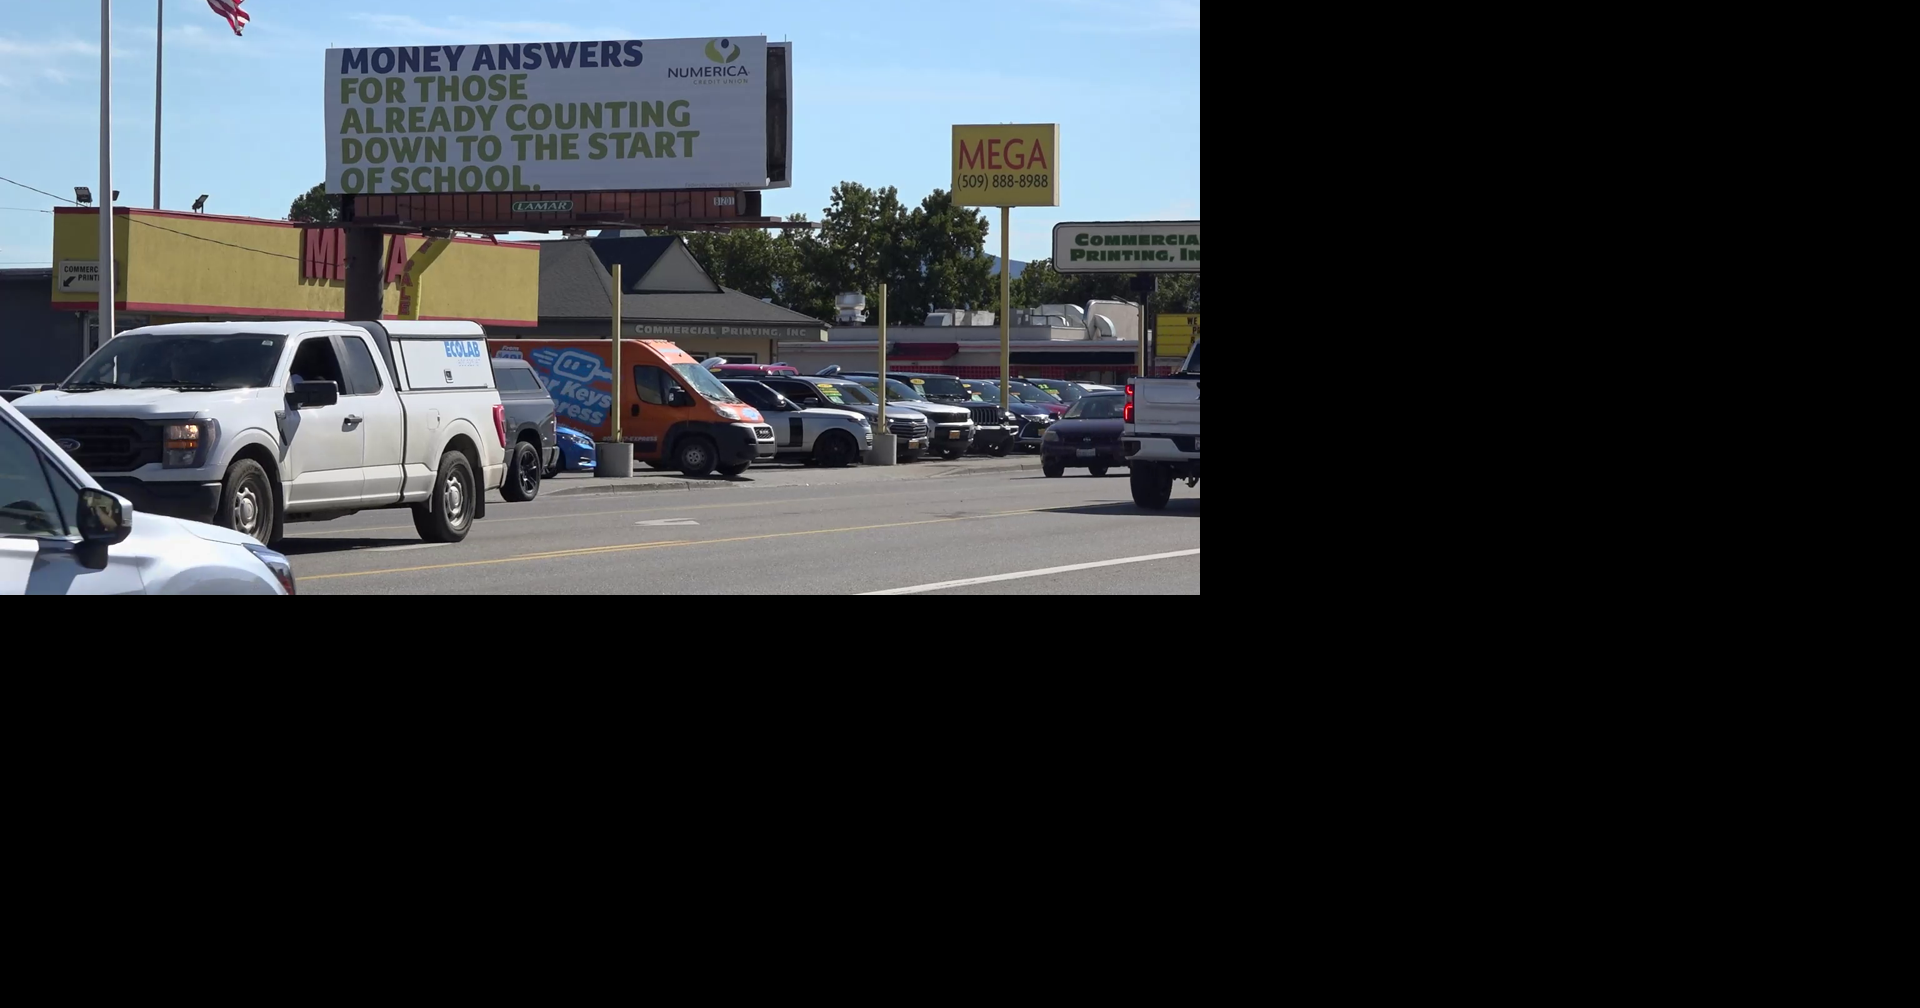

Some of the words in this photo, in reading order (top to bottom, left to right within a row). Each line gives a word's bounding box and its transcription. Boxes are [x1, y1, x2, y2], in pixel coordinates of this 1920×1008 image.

[341, 45, 466, 74] MONEY
[471, 39, 643, 71] ANSWERS
[667, 65, 748, 78] NUMERICA
[341, 77, 407, 104] FOR
[413, 74, 528, 103] THOSE
[340, 104, 498, 134] ALREADY
[505, 99, 690, 131] COUNTING
[341, 136, 446, 164] DOWN
[456, 134, 502, 162] TO
[510, 132, 580, 161] THE
[588, 130, 700, 160] START
[958, 138, 1048, 170] MEGA
[340, 167, 385, 194] OF
[390, 164, 541, 194] SCHOOL.
[957, 173, 989, 191] (509)
[992, 174, 1048, 188] 888-8988
[517, 202, 567, 210] LAMAR
[1074, 233, 1200, 246] COMMERCIA
[1070, 248, 1175, 263] PRINTING,
[1180, 248, 1200, 261] IN
[635, 324, 716, 335] COMMERCIAL
[722, 326, 782, 337] PRINTING,
[787, 328, 806, 336] INC
[444, 341, 481, 357] ECOLAB
[561, 381, 612, 409] Keys
